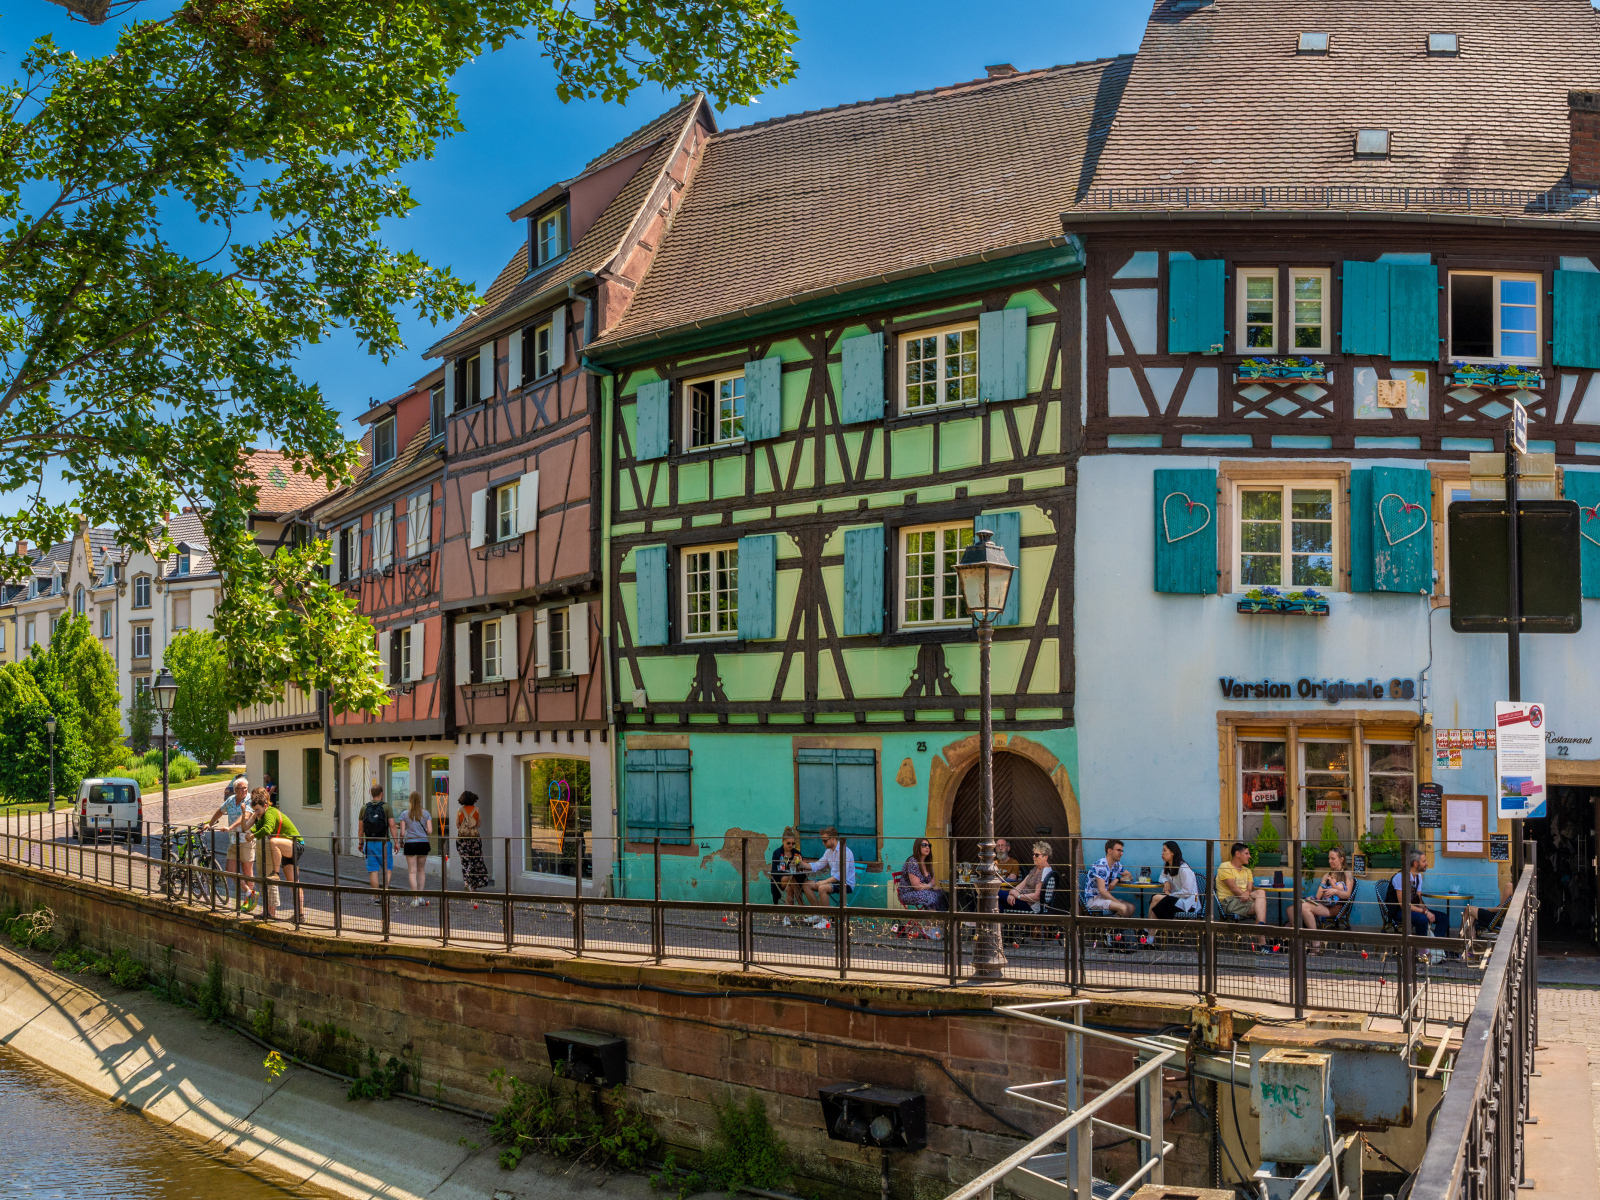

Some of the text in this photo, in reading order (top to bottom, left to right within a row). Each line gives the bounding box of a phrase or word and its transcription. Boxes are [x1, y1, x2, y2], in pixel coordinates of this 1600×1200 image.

[1219, 678, 1415, 704] Version Originale 68
[1545, 730, 1593, 744] Restaurant
[916, 741, 927, 752] 23
[1557, 745, 1569, 756] 22
[1254, 794, 1276, 802] OPEN
